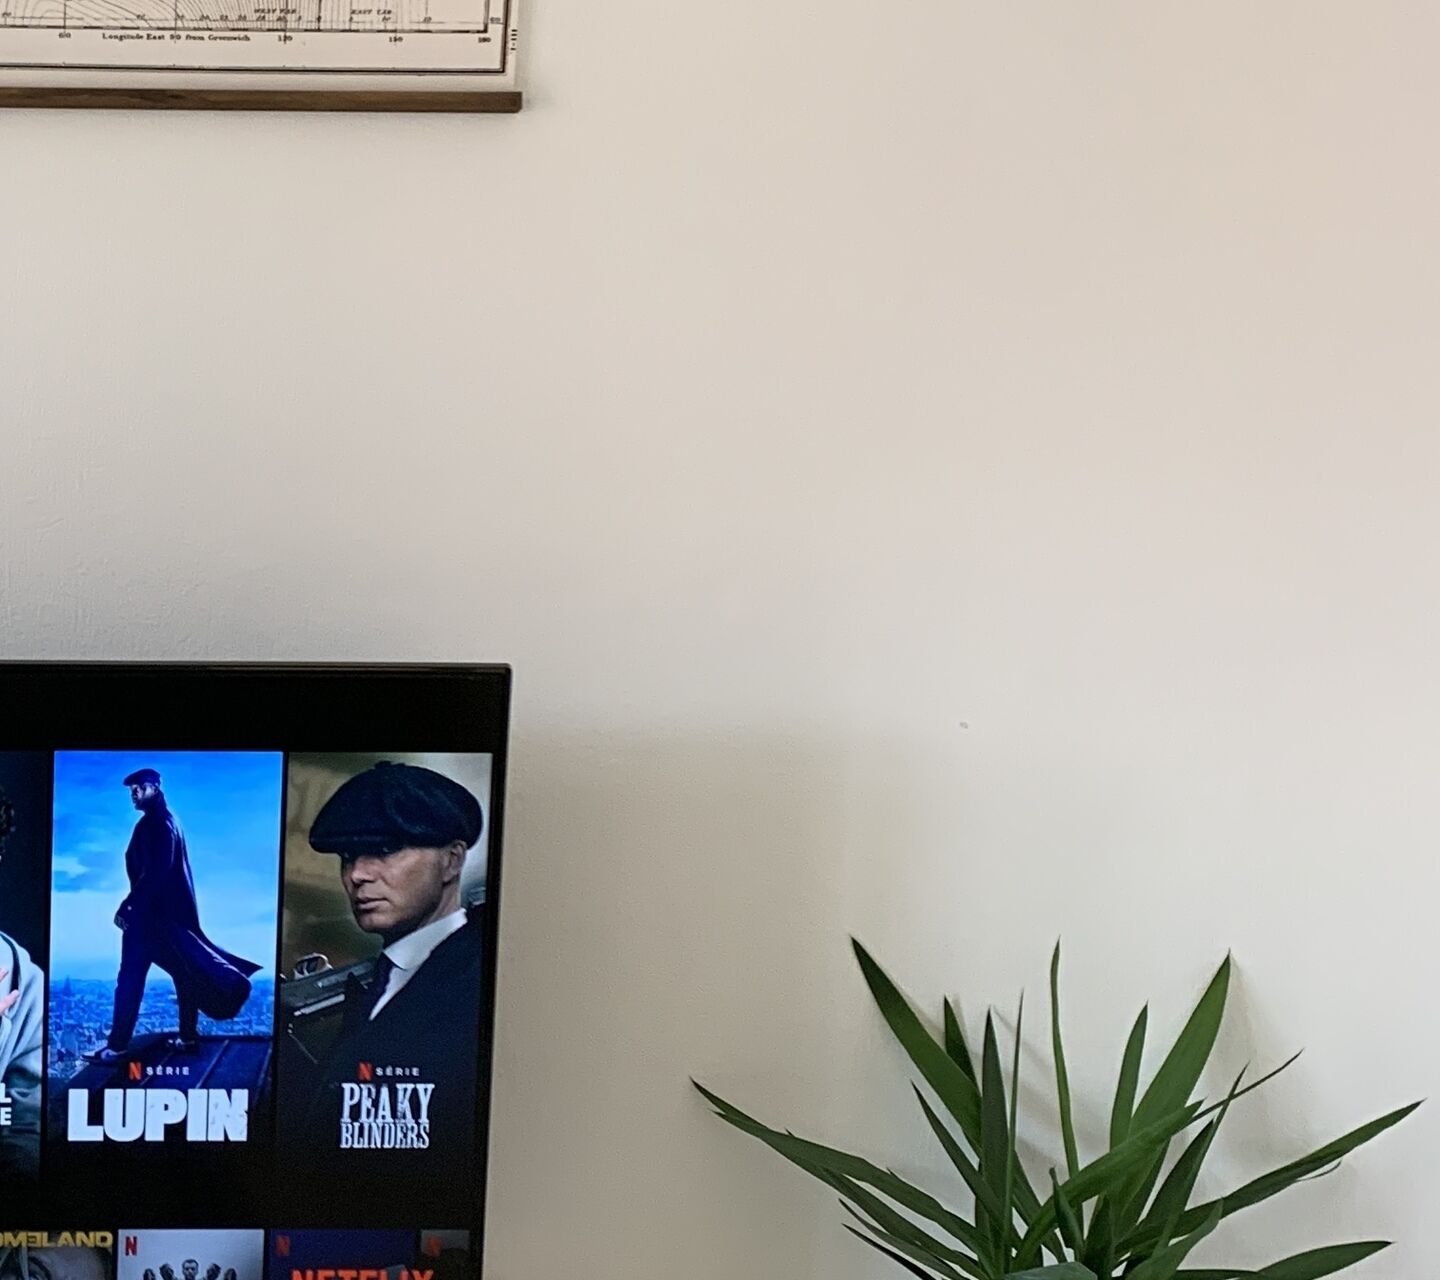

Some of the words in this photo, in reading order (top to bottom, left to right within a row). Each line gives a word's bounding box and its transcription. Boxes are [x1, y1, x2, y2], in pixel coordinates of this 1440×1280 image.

[129, 1062, 141, 1080] N
[146, 1065, 190, 1076] SÉRIE
[358, 1063, 371, 1081] N
[376, 1065, 420, 1077] SÉRIE
[340, 1083, 435, 1123] PEAKY
[67, 1088, 249, 1143] LUPIN
[339, 1122, 430, 1148] BLINDERS
[125, 1236, 137, 1256] N
